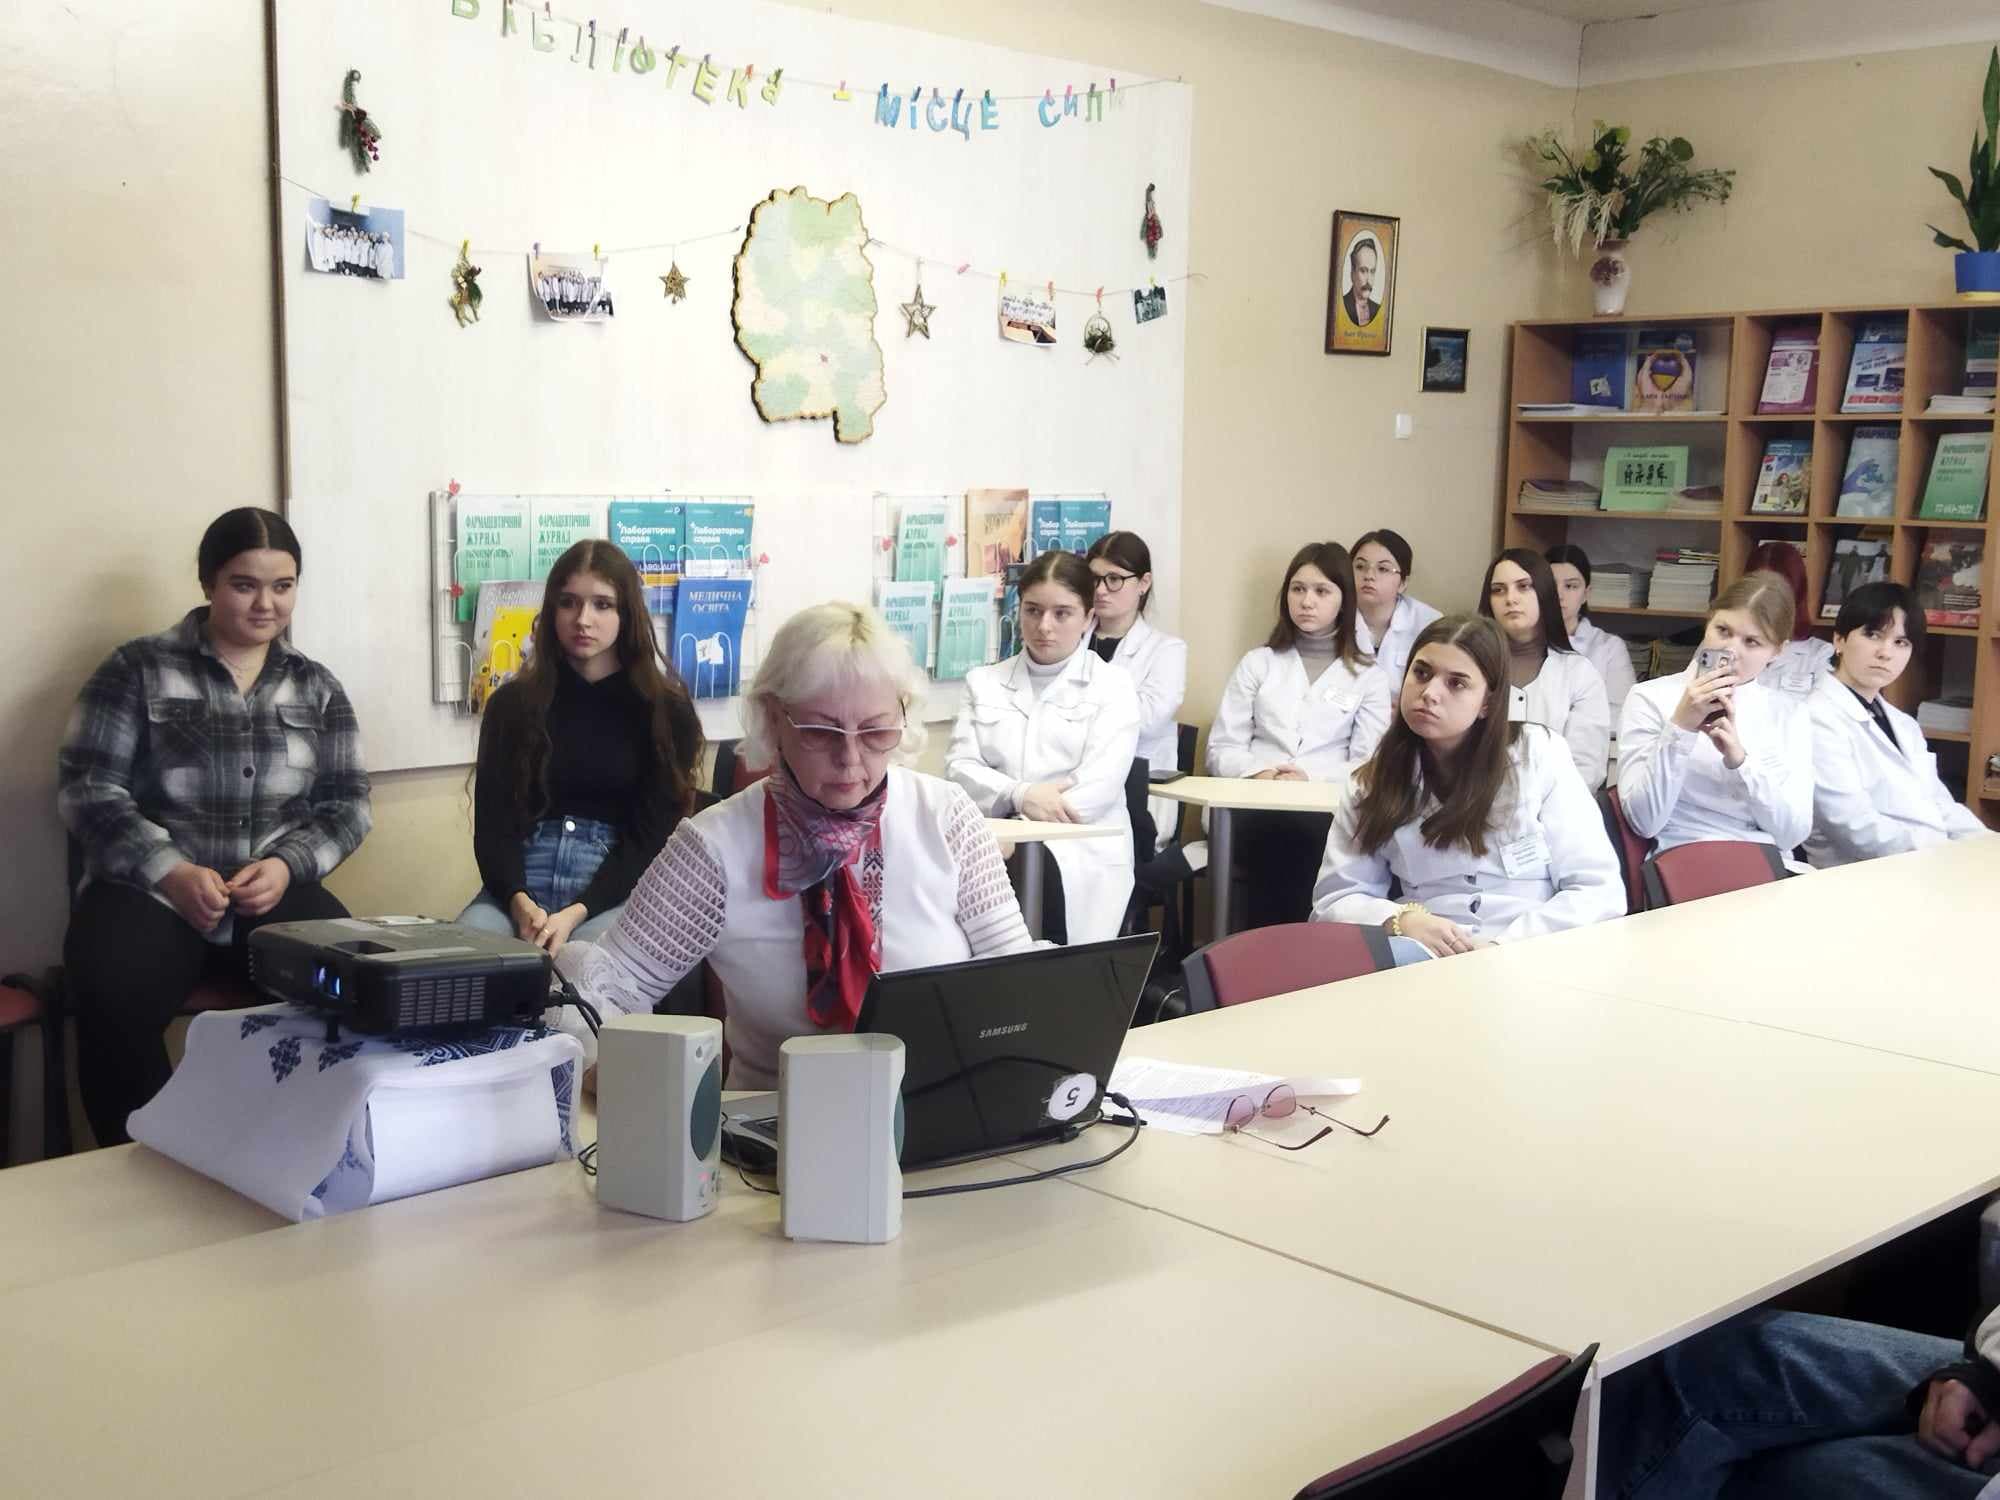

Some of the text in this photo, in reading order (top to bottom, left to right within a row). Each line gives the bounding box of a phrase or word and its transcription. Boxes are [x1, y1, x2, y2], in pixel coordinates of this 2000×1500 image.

[875, 90, 1000, 142] МІСЦЕ
[466, 532, 501, 545] ЖУРНАЛ
[538, 531, 571, 545] ЖУРНАЛ
[620, 525, 676, 537] Лабораторна
[979, 1022, 1029, 1039] SAMSUNG
[1065, 1086, 1081, 1108] 5
